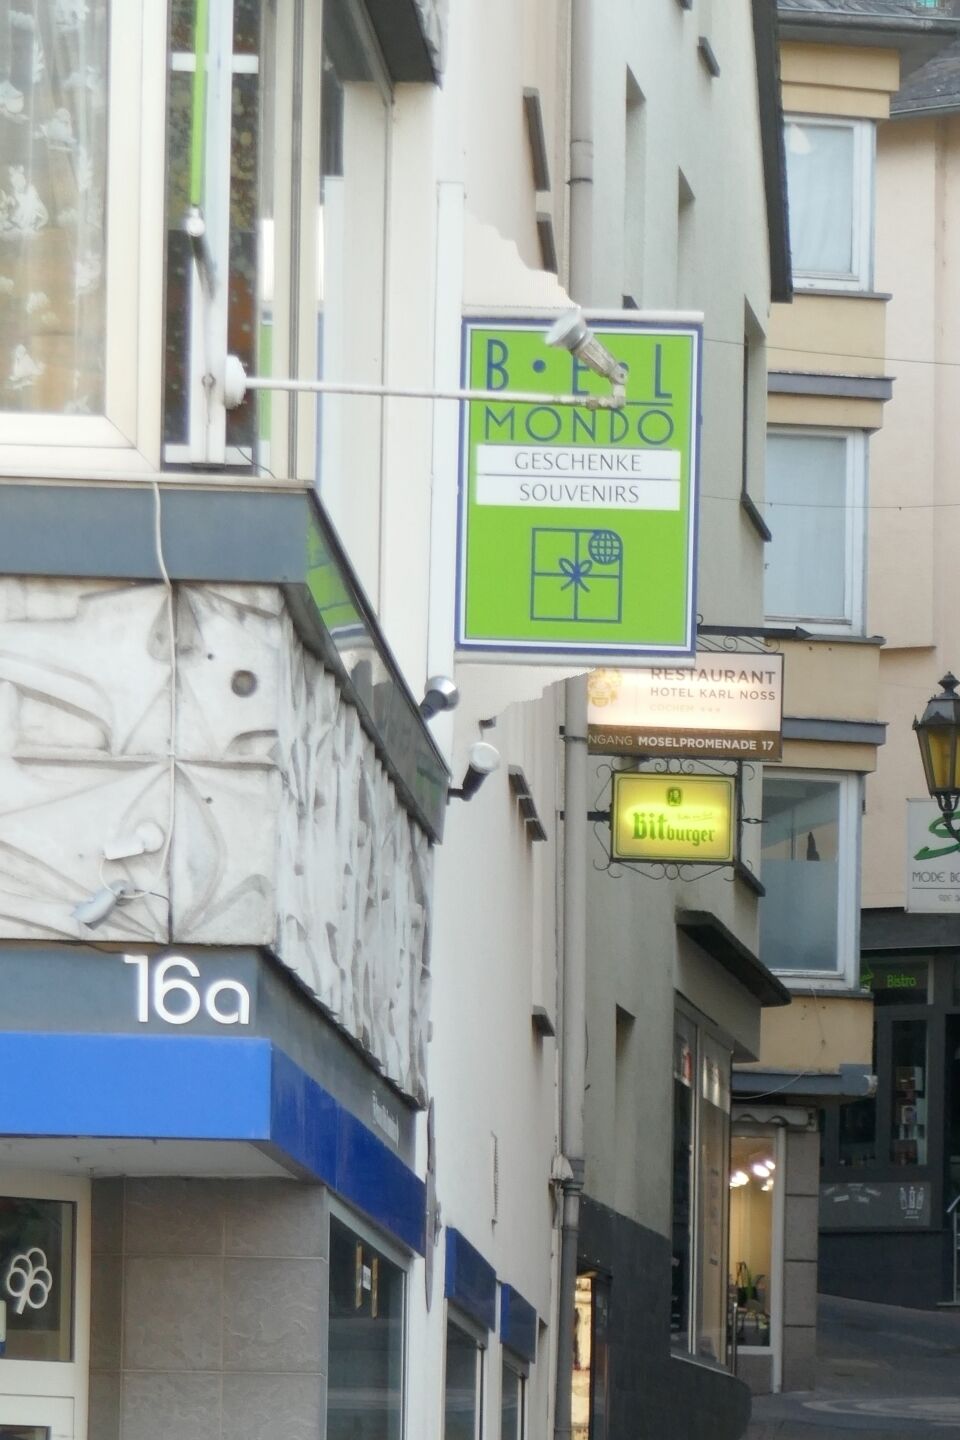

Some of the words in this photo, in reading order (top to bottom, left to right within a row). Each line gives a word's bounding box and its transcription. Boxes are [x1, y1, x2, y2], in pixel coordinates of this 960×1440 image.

[485, 405, 674, 445] MONDO
[514, 452, 642, 472] GESCHENKE
[519, 483, 640, 503] SOUVENIRS
[650, 668, 776, 685] RESTAURANT
[650, 687, 694, 698] HOTEL
[700, 689, 734, 700] KARL
[740, 690, 776, 701] NOSS
[638, 736, 757, 750] MOSELPROMENADE
[762, 741, 775, 751] 17
[632, 812, 716, 846] Bitburger
[912, 871, 945, 882] MODE
[123, 954, 250, 1025] 16a
[887, 973, 917, 988] Bistro
